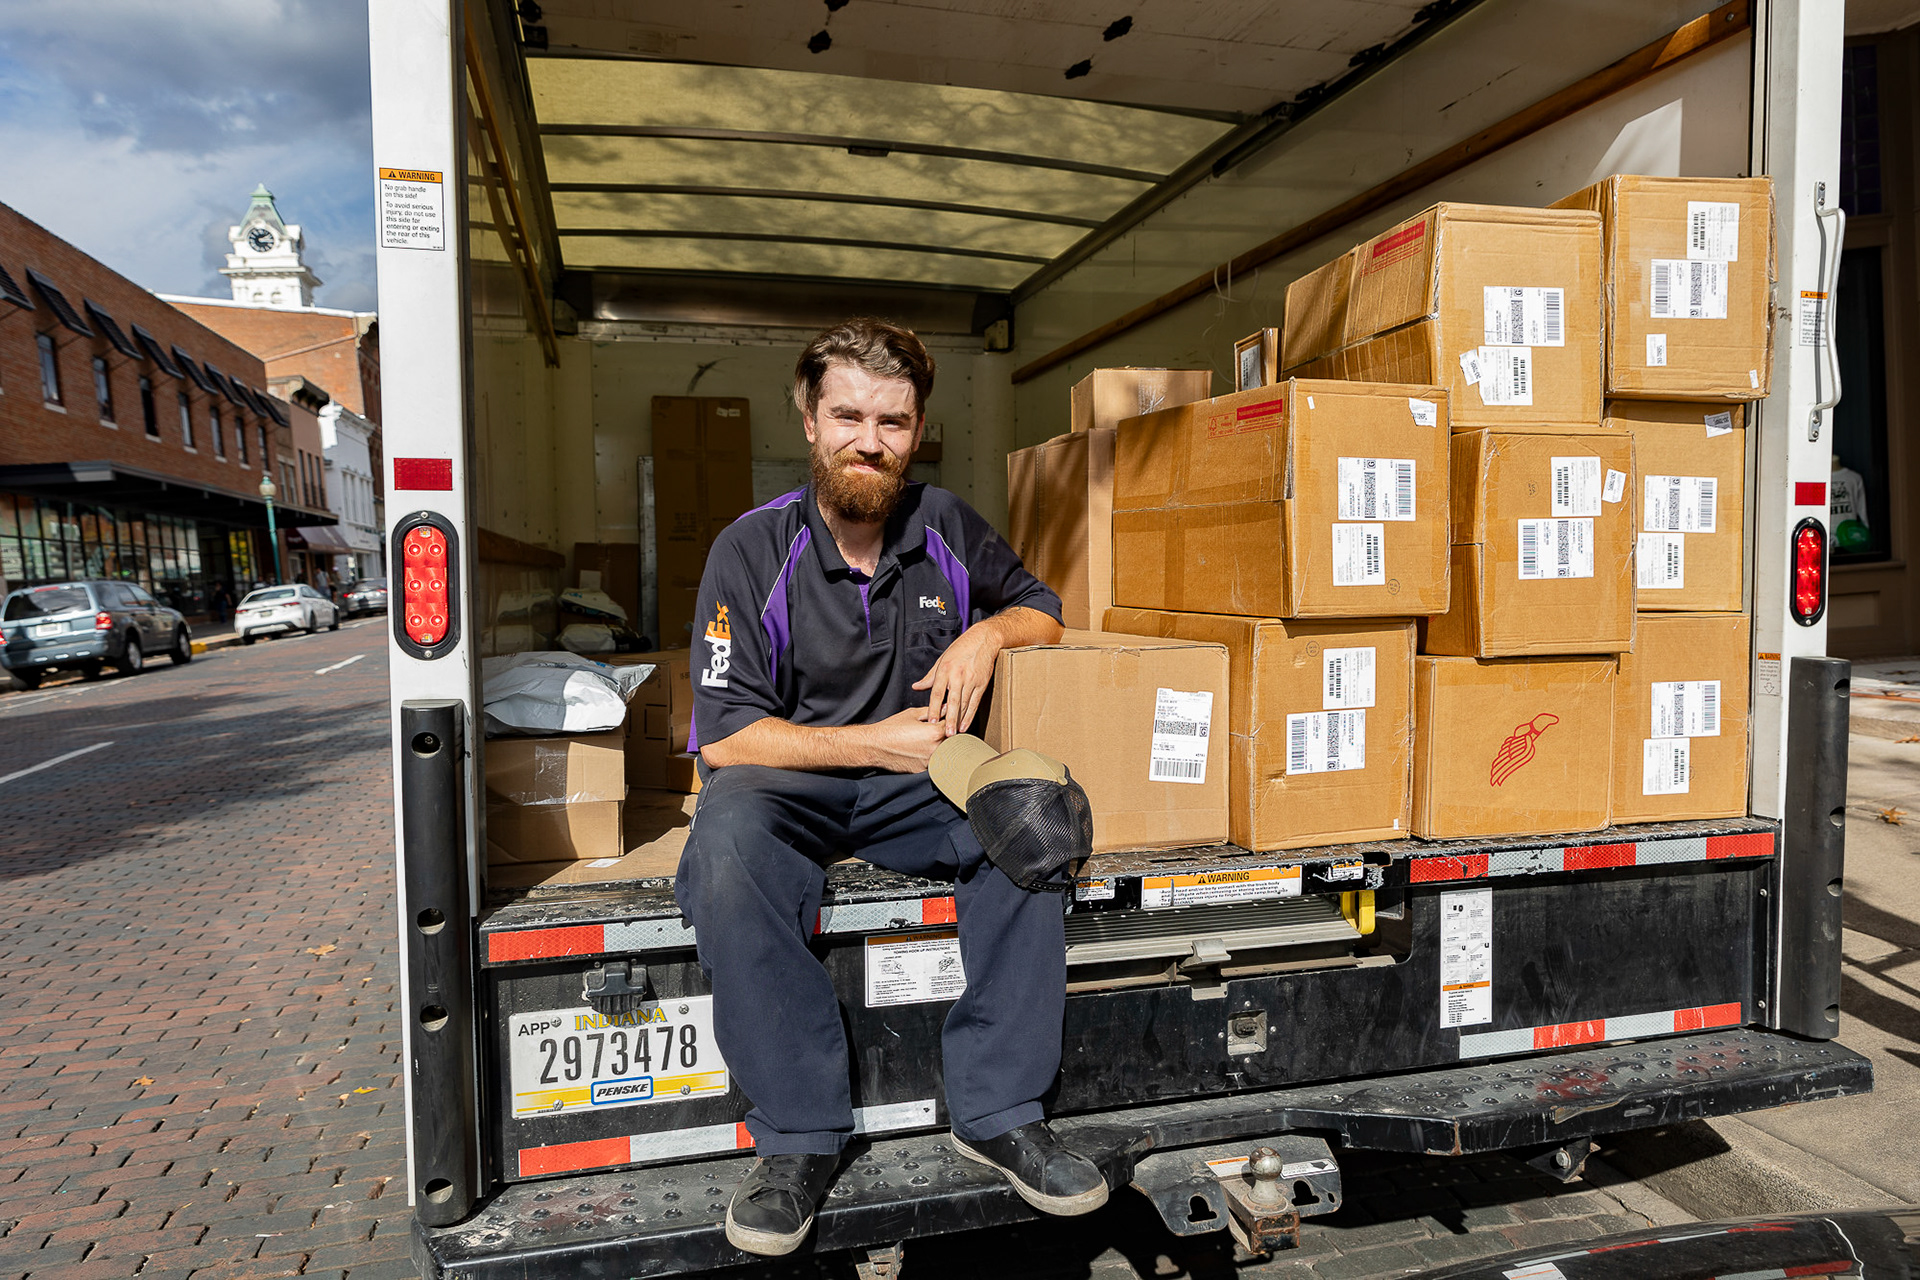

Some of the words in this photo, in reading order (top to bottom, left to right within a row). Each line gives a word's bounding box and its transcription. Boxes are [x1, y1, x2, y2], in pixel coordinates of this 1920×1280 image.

[399, 171, 435, 180] WARNING
[920, 596, 946, 610] FedEx
[701, 600, 731, 688] FedEx
[1207, 872, 1249, 883] WARNING
[574, 1007, 668, 1032] INDIANA
[518, 1022, 550, 1036] APP
[540, 1024, 697, 1085] 2973478
[596, 1084, 648, 1097] PENSKE
